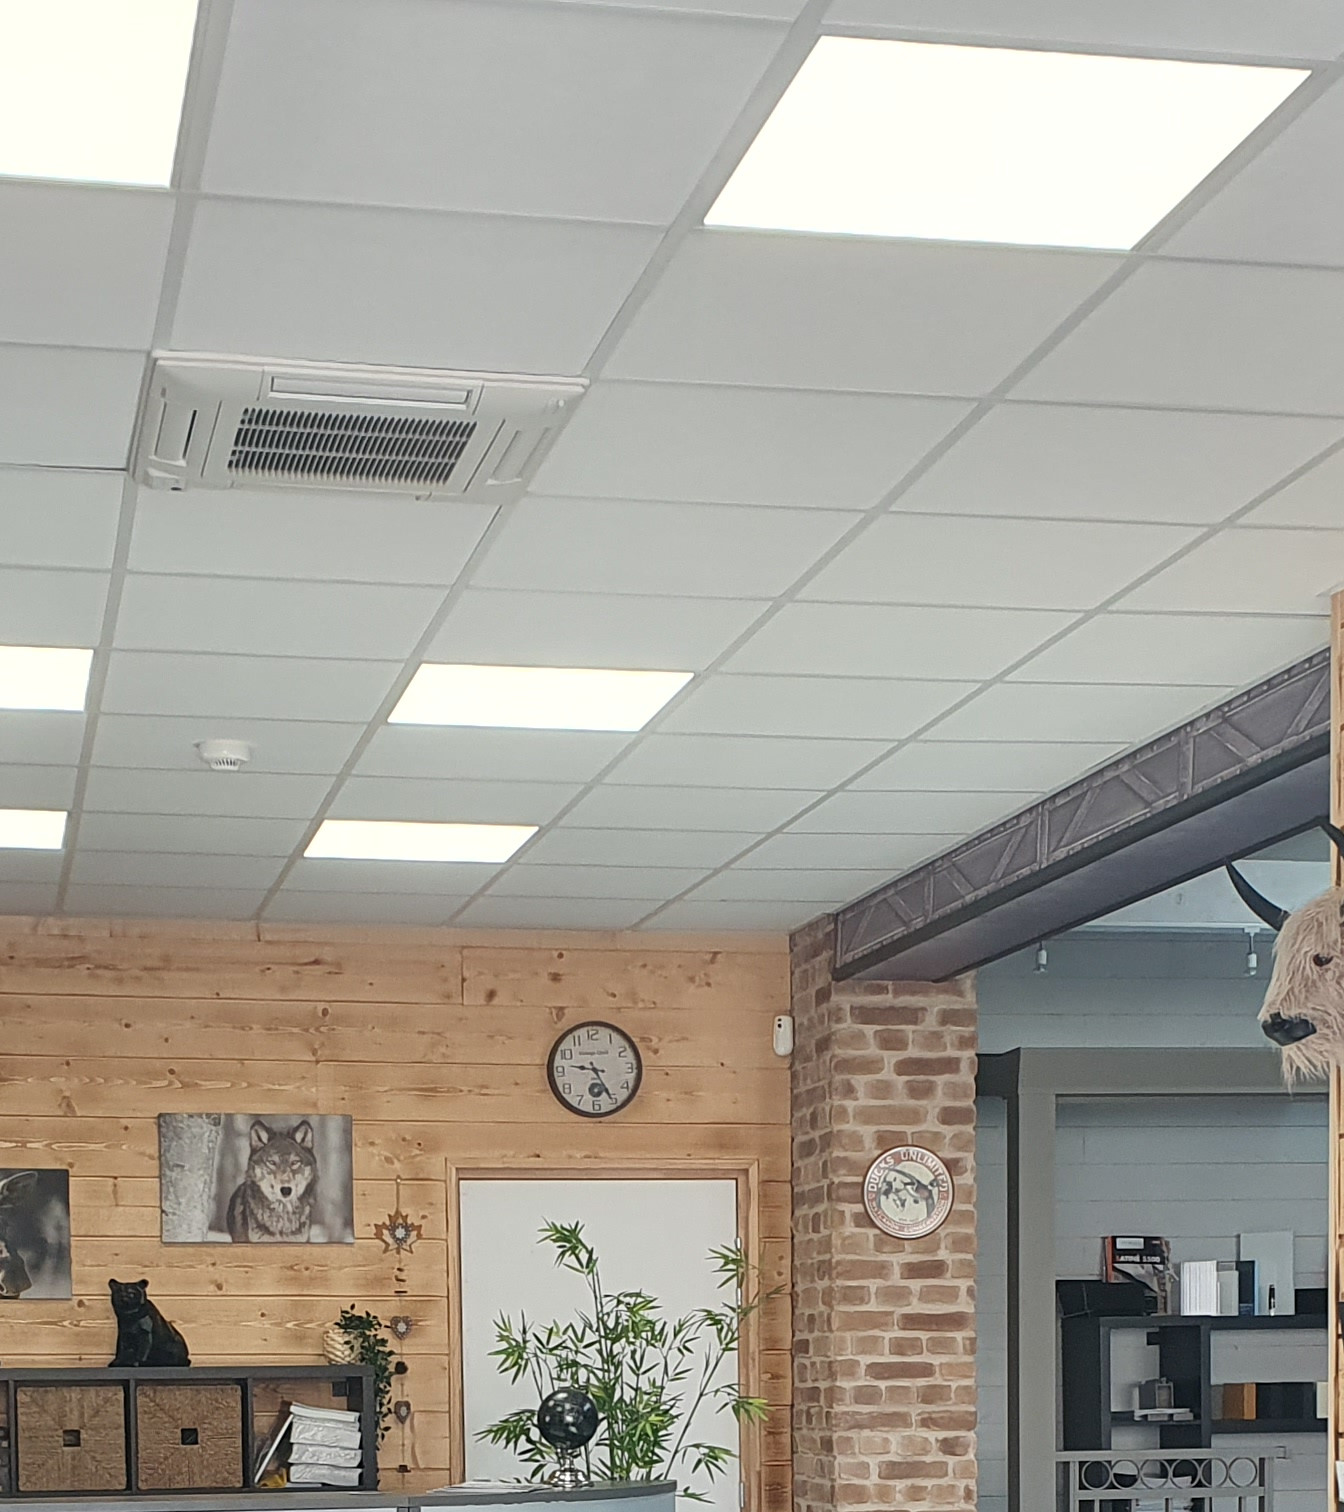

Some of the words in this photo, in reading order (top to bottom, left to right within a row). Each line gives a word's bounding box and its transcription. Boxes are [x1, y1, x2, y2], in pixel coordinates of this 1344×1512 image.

[586, 1029, 599, 1041] 12
[560, 1048, 573, 1061] 10
[618, 1046, 628, 1058] 2
[556, 1065, 565, 1078] 9
[624, 1062, 634, 1074] 3
[562, 1083, 572, 1095] 8
[619, 1080, 630, 1092] 4
[576, 1094, 585, 1106] 7
[592, 1099, 602, 1112] 6
[868, 1155, 895, 1192] DUCKS
[900, 1150, 948, 1192] UNLIMITED
